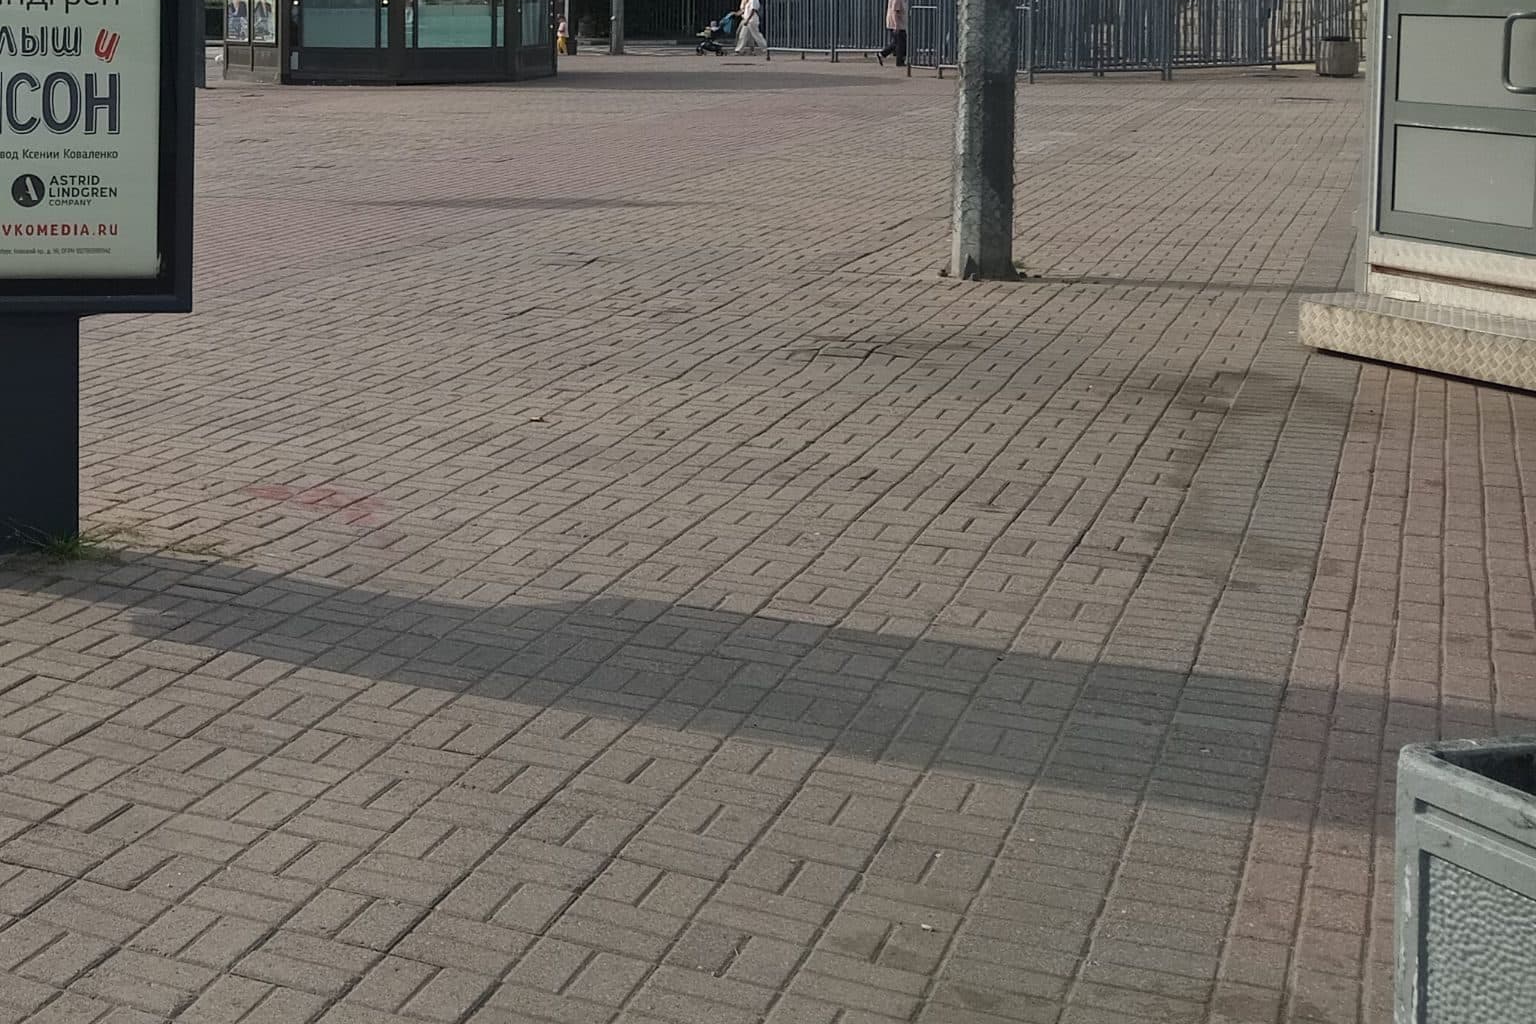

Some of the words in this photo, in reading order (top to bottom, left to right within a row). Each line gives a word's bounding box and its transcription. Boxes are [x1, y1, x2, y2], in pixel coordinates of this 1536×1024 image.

[22, 148, 60, 160] Ксении
[63, 148, 119, 160] Коваленко
[49, 175, 101, 186] ASTRID
[48, 187, 118, 198] LINDGREN
[48, 199, 93, 207] COMPANY
